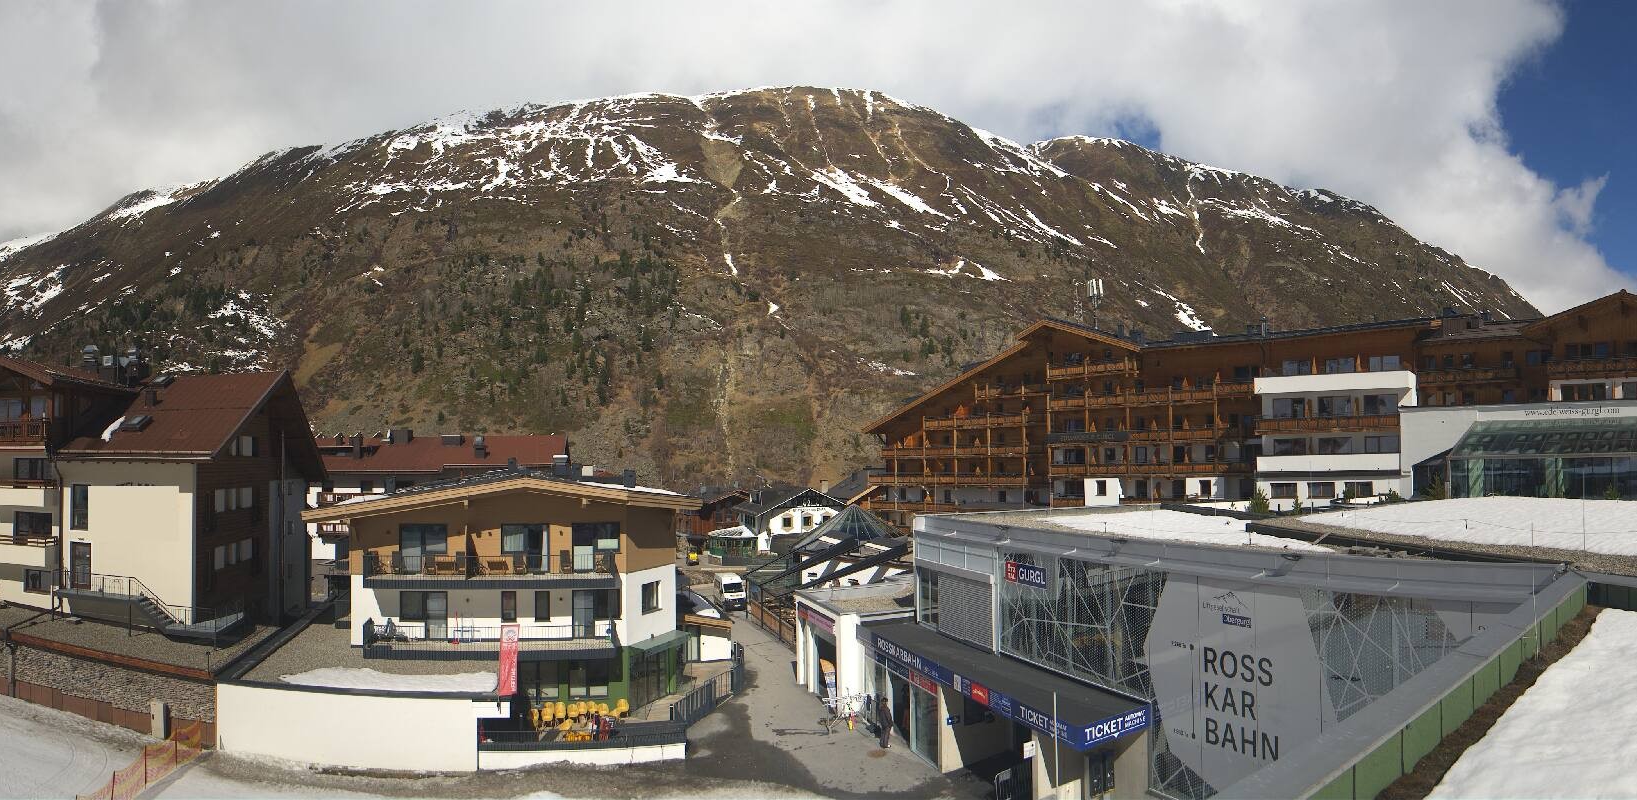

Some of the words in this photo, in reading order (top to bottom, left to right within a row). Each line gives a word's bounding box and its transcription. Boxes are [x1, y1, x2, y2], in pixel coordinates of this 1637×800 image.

[1018, 567, 1045, 585] GURGL
[877, 637, 922, 671] ROSSKARBAHN
[1204, 646, 1273, 687] ROSS
[1204, 681, 1256, 721] KAR
[1019, 705, 1049, 729] TICKET
[1084, 717, 1124, 741] TICKET
[1124, 715, 1146, 728] MACHINE
[1205, 717, 1279, 761] BAHN
